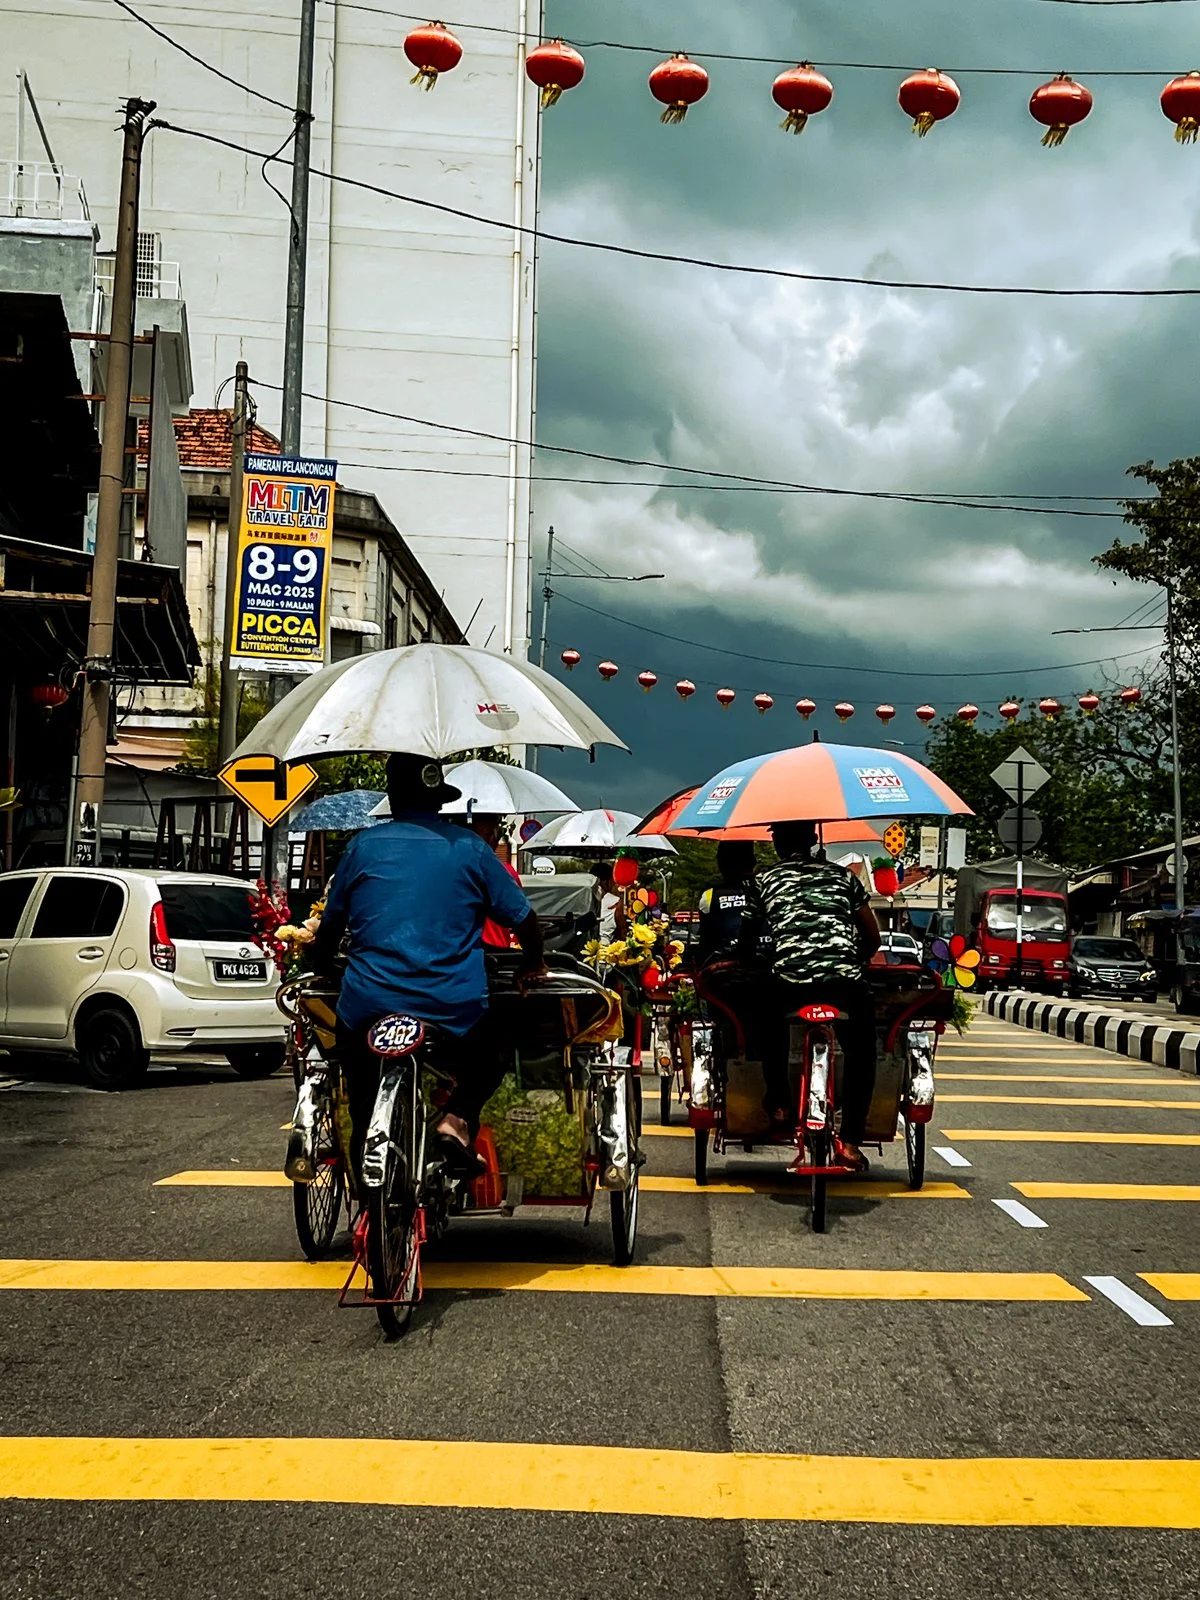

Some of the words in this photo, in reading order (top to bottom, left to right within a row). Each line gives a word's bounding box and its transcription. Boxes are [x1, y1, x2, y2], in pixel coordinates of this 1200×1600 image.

[247, 458, 281, 472] PAMERAN
[282, 461, 334, 476] PELANCONGAN
[249, 480, 330, 515] MITM
[248, 510, 294, 525] TRAVEL
[298, 513, 327, 528] FAIR
[248, 545, 318, 584] 8-9
[247, 582, 282, 595] MAC
[283, 585, 315, 598] 2025
[246, 598, 255, 606] 10
[256, 599, 274, 608] PAGI
[285, 601, 314, 610] MALAM
[241, 612, 317, 637] PICCA
[241, 633, 289, 643] CONVENTION
[289, 636, 317, 646] CENTRE
[238, 963, 260, 976] 4623
